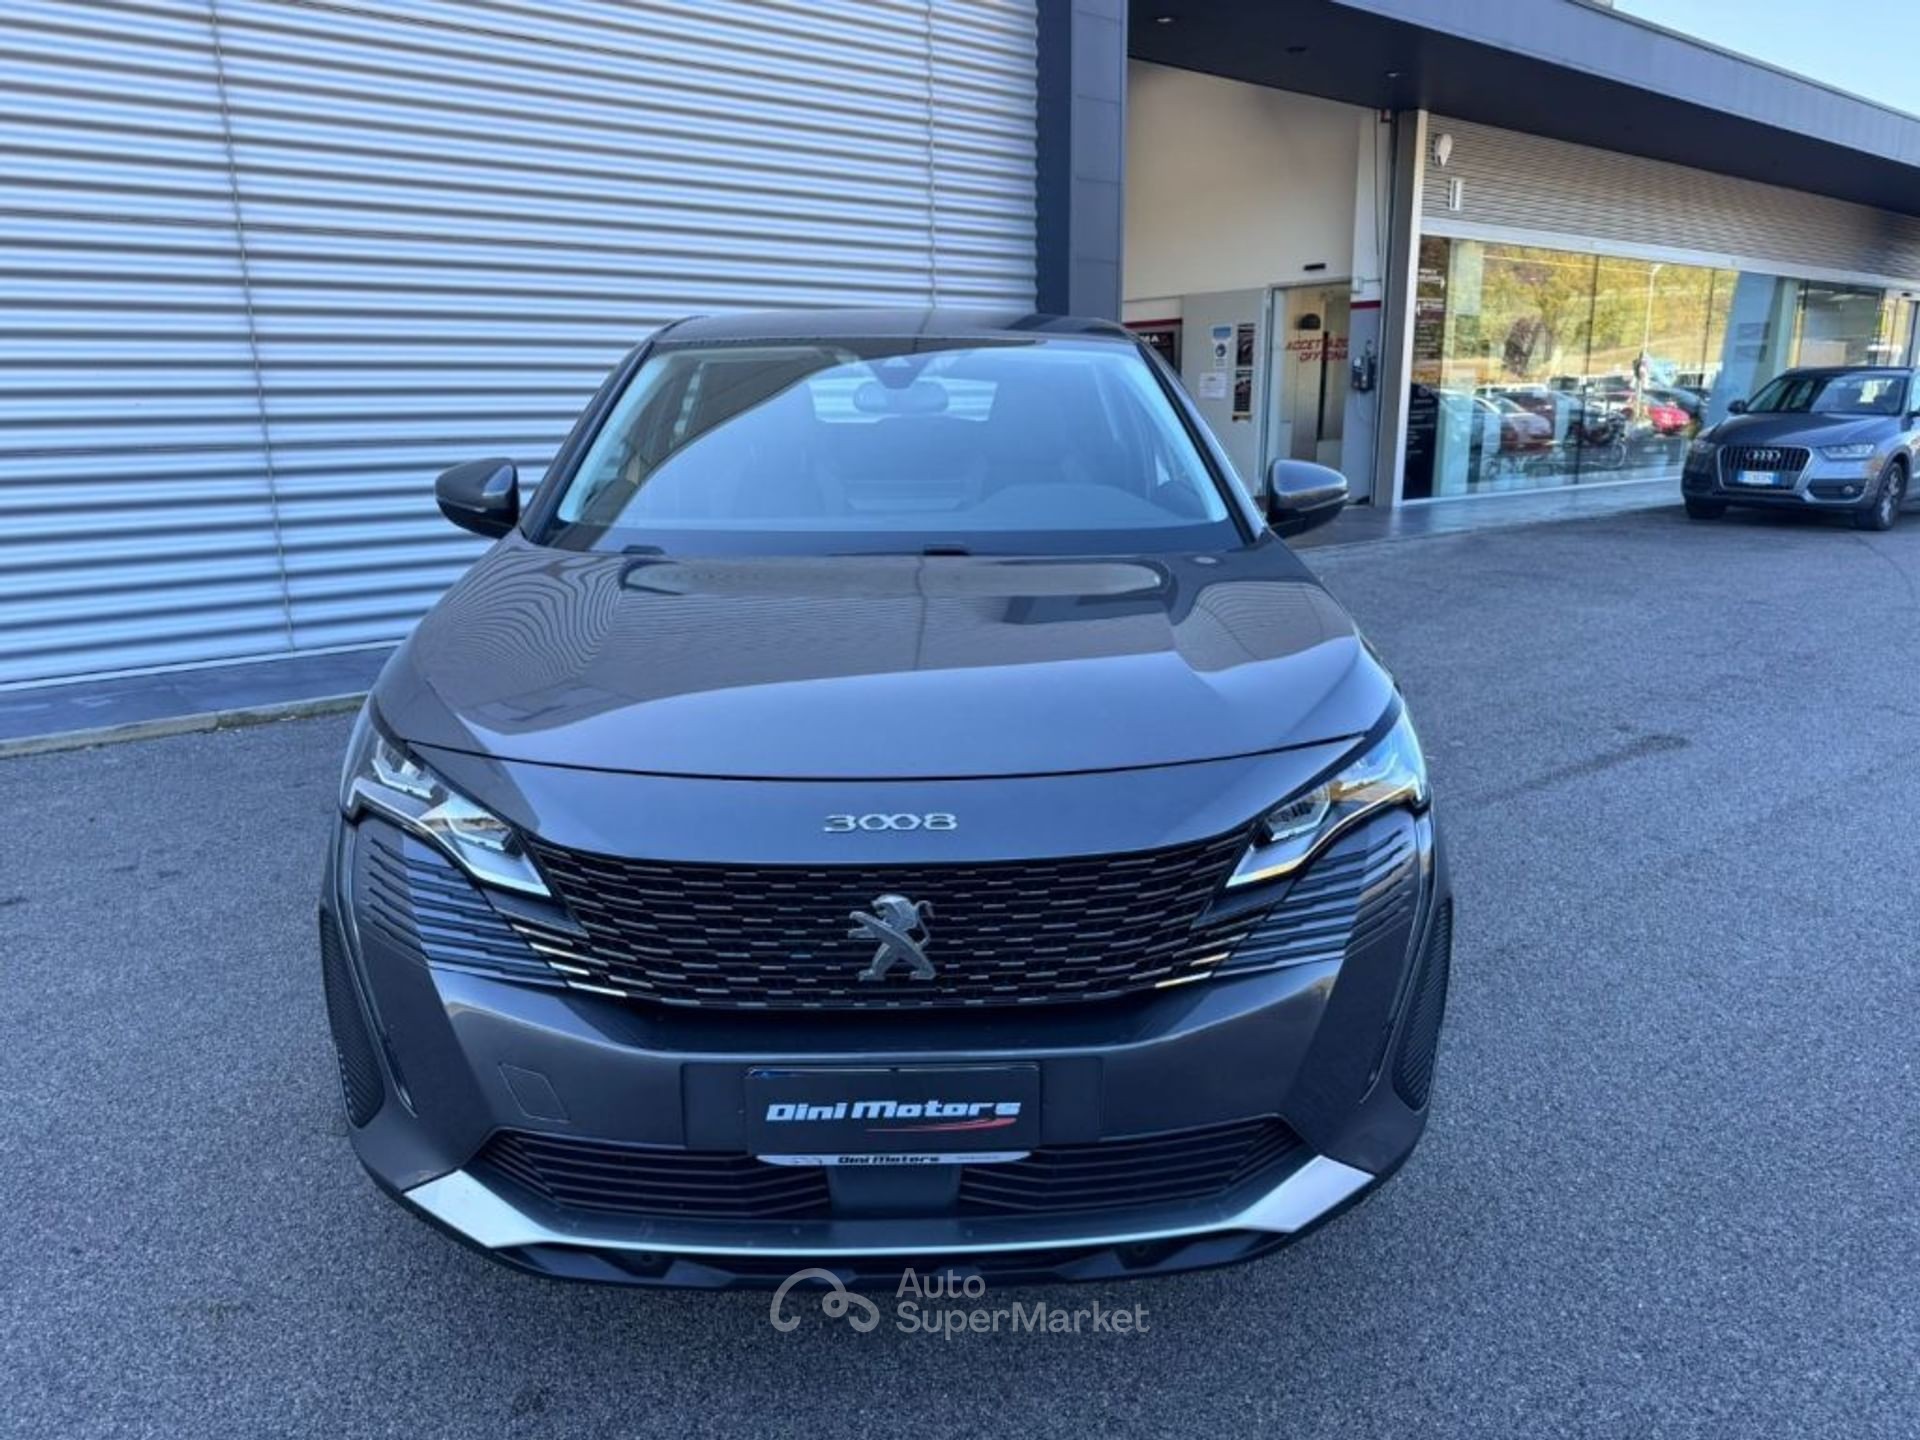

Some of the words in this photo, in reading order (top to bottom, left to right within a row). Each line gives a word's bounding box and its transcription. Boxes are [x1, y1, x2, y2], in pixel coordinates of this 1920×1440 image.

[824, 813, 957, 832] 3008
[766, 1101, 846, 1121] Dini
[851, 1099, 1022, 1118] Motors
[871, 1155, 940, 1164] Motors
